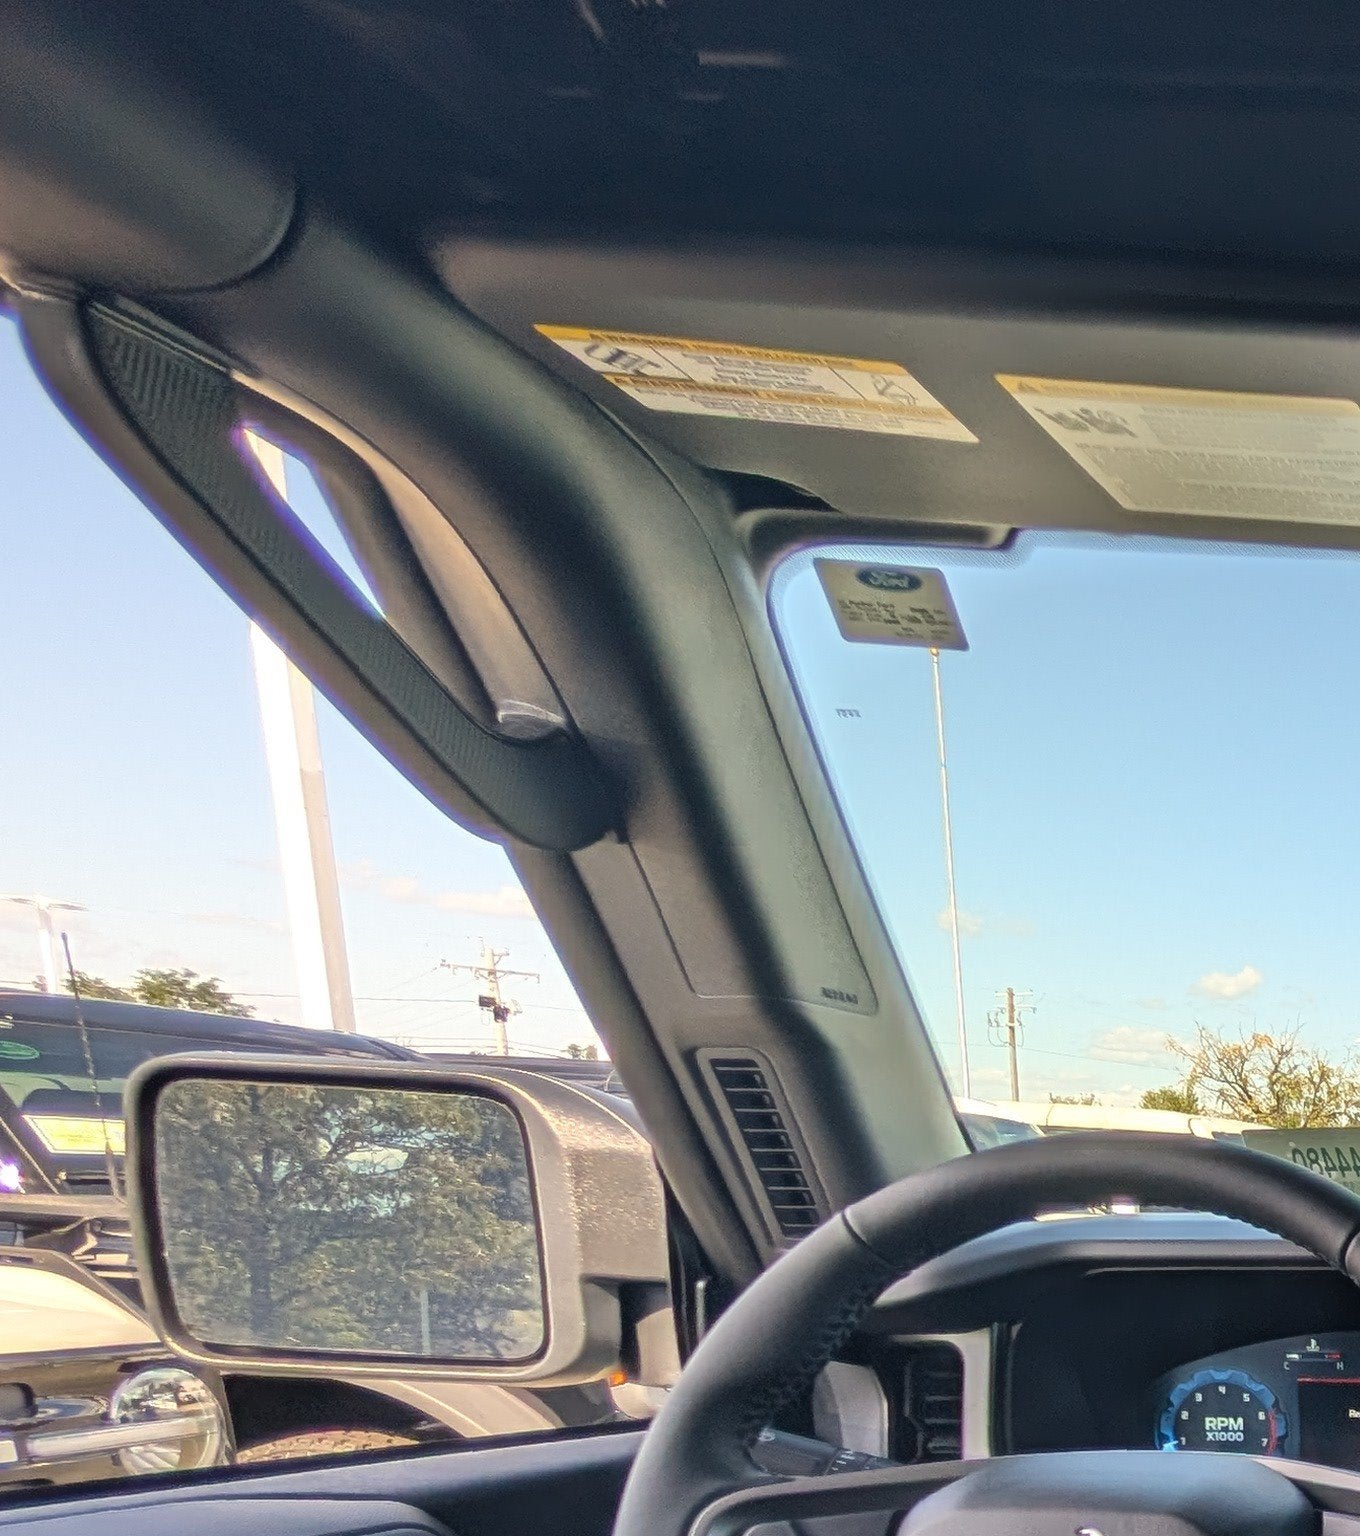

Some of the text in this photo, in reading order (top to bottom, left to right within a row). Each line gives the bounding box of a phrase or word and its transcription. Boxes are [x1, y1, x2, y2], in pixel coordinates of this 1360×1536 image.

[1218, 1385, 1226, 1395] 4
[1195, 1392, 1203, 1402] 3
[1242, 1393, 1250, 1402] 5
[1180, 1411, 1189, 1420] 2
[1258, 1411, 1266, 1420] 6
[1204, 1417, 1244, 1431] RPM
[1206, 1432, 1244, 1442] X1000
[1261, 1438, 1269, 1447] 7
